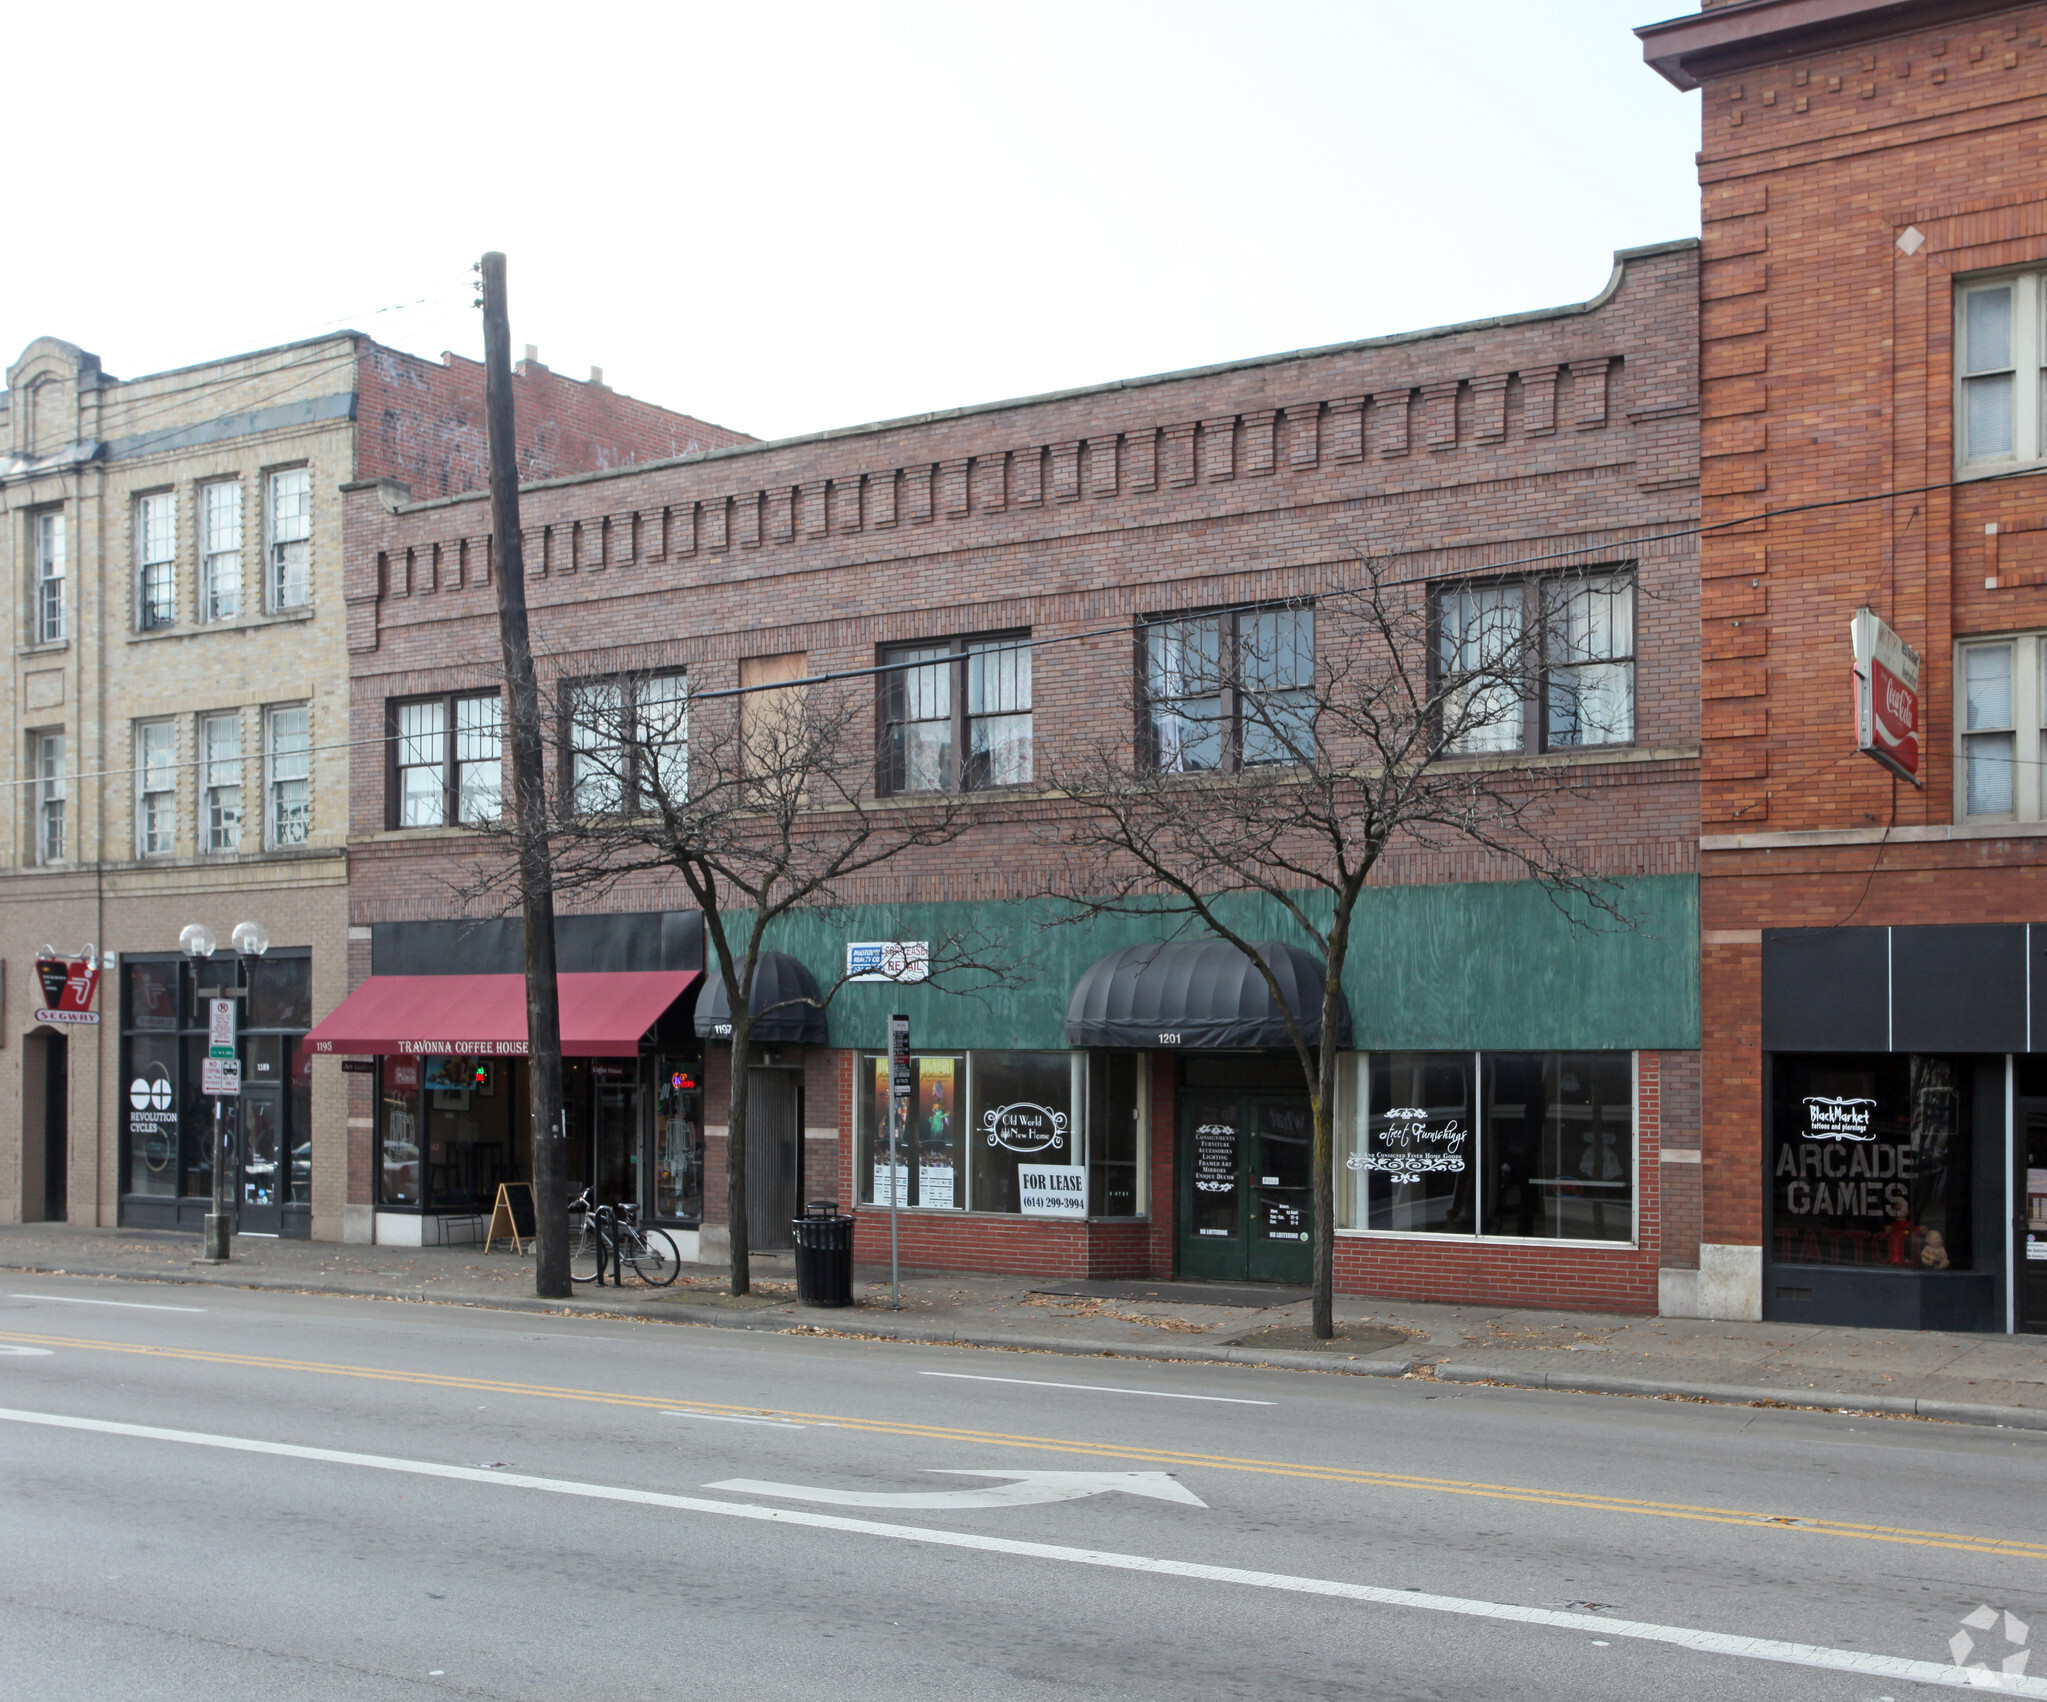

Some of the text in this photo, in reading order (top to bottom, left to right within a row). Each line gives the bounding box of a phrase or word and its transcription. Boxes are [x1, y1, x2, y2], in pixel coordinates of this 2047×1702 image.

[905, 945, 927, 956] LEASE
[887, 960, 922, 972] RETAIL
[40, 1011, 97, 1022] SEGWAY
[714, 1024, 732, 1035] 1197
[1158, 1033, 1181, 1044] 1201
[316, 1041, 333, 1052] 1195
[397, 1040, 529, 1054] TRAVONNA COFFEE HOUSE
[257, 1063, 270, 1071] 1189
[130, 1111, 177, 1122] REVOLUTION
[1002, 1114, 1042, 1127] Old World
[130, 1122, 158, 1133] CYCLES
[1811, 1122, 1867, 1133] tattoos and piercings
[1011, 1128, 1050, 1140] New Home
[1411, 1120, 1467, 1154] Furnishings
[1775, 1143, 1919, 1179] ARCADE
[1022, 1174, 1083, 1192] FOR LEASE
[1023, 1196, 1085, 1210] (614) 299-3994
[1787, 1181, 1909, 1217] GAMES
